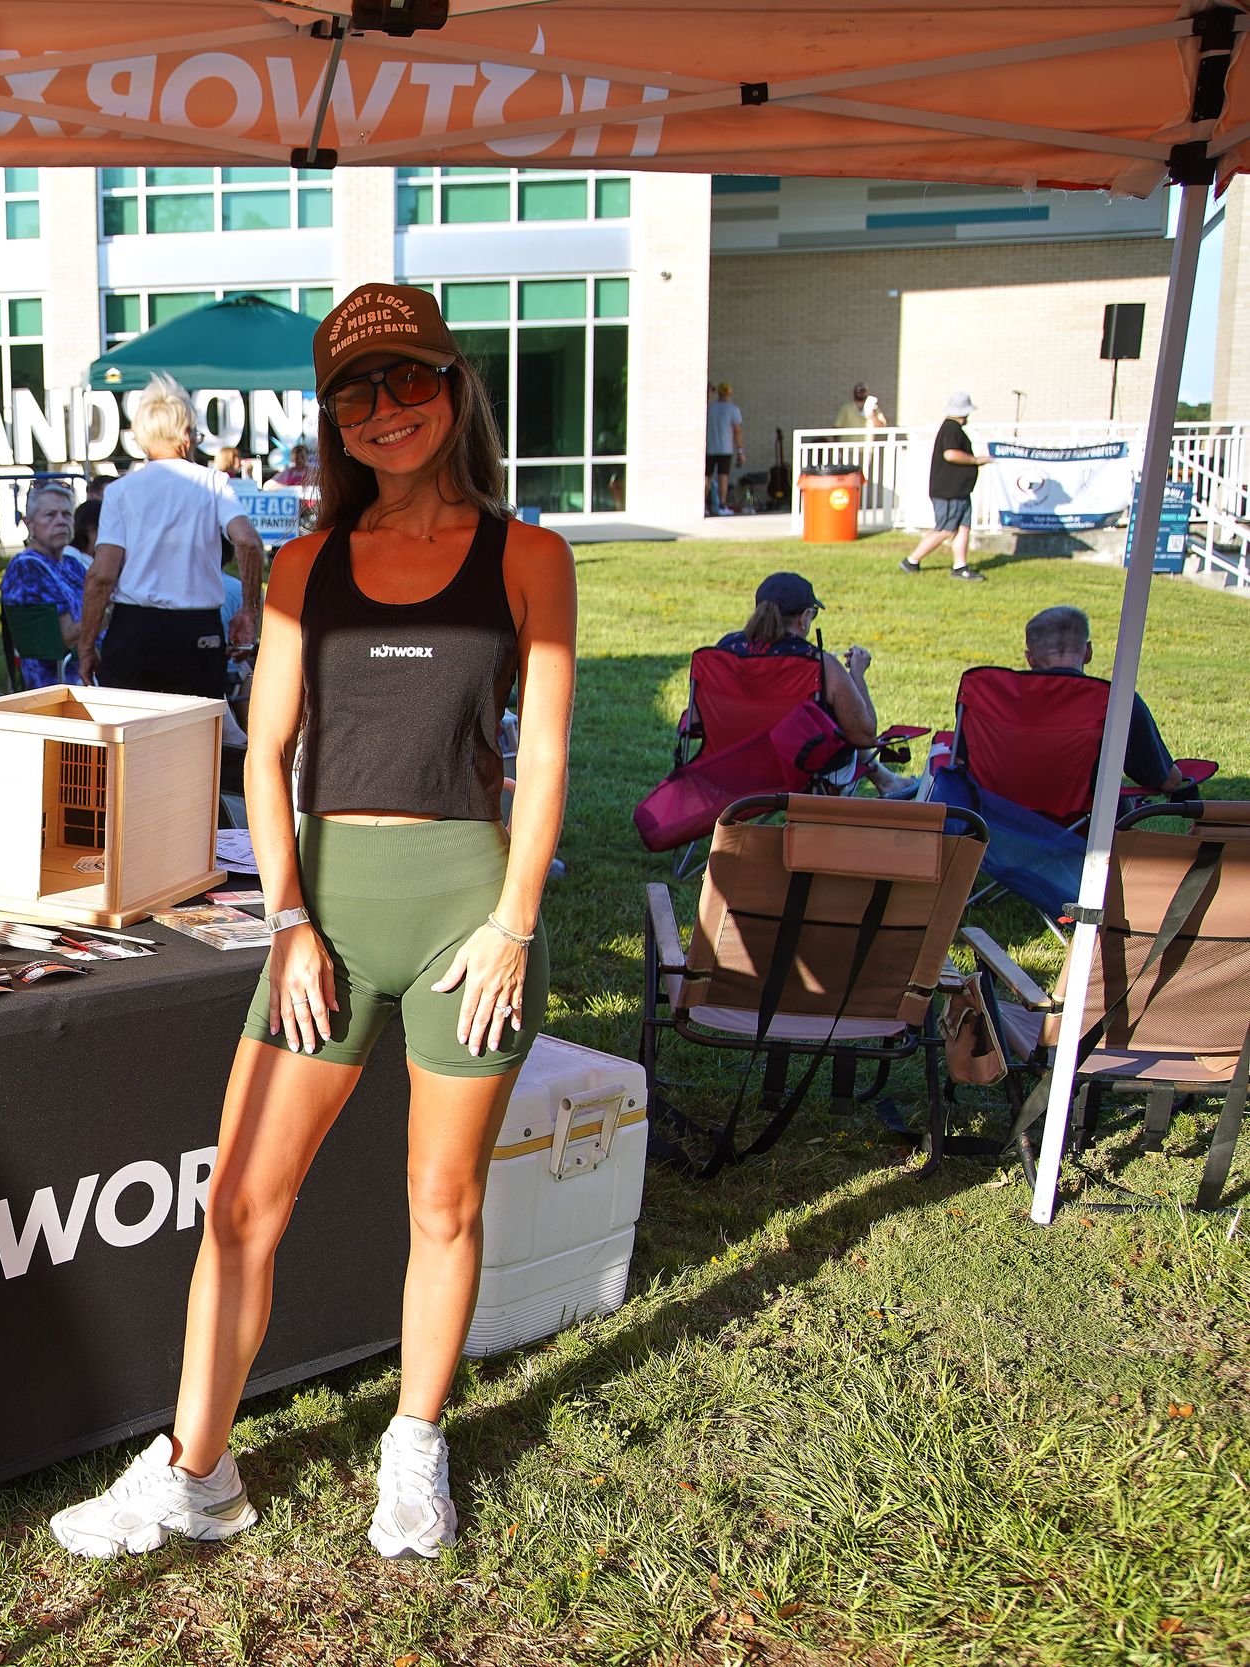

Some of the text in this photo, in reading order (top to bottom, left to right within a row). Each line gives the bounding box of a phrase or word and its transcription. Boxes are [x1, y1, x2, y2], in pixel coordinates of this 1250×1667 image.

[329, 293, 415, 342] SUPPORT LOCAL
[347, 308, 392, 332] MUSIC
[330, 332, 359, 358] BANDS
[384, 323, 418, 334] BAYOU
[370, 644, 433, 658] HOTWORX
